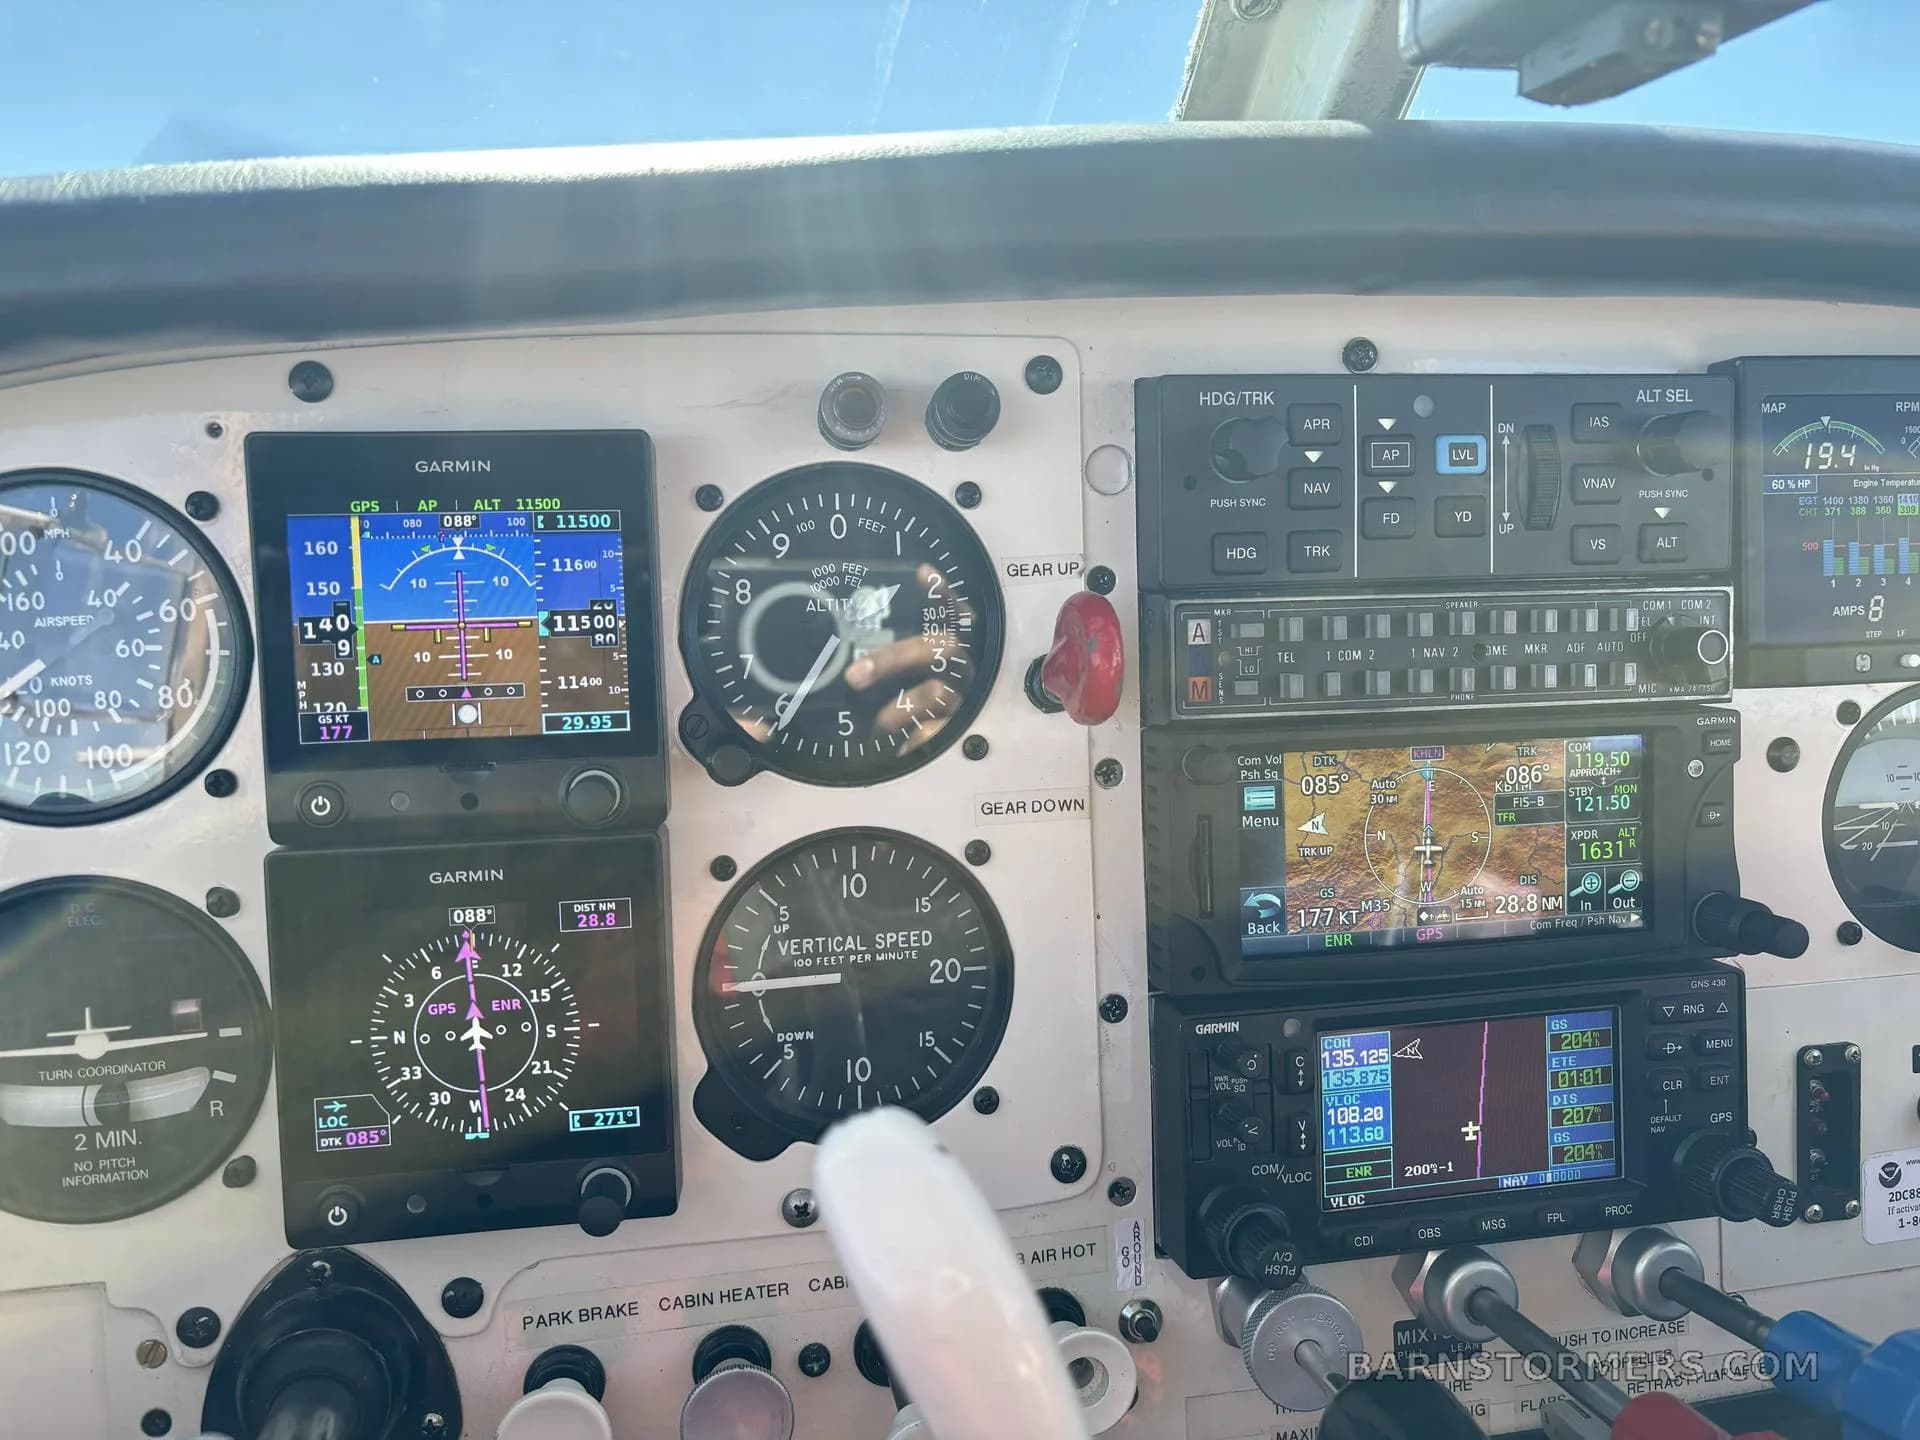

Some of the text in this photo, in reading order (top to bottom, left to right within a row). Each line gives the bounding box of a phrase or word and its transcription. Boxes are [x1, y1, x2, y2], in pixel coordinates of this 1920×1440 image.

[1199, 391, 1275, 406] HDG/TRK
[1636, 389, 1693, 403] ALT SEL
[1761, 403, 1786, 413] MAP
[1896, 402, 1919, 412] RPM
[1303, 418, 1331, 430] APR
[1498, 423, 1514, 433] DN
[1589, 416, 1609, 428] IAS
[1382, 449, 1400, 461] AP
[1452, 449, 1474, 460] LVL
[1804, 443, 1857, 470] 19.4
[415, 459, 491, 473] GARMIN
[1304, 482, 1331, 494] NAV
[1583, 478, 1616, 489] VNAV
[1772, 479, 1811, 489] 60 HP
[1853, 479, 1879, 488] Engine
[1639, 490, 1663, 498] PUSH
[351, 498, 561, 512] GPS AP ALT 11500
[1210, 498, 1266, 508] PUSH SYNC
[1454, 511, 1472, 522] YD
[1825, 507, 1841, 515] 371
[556, 514, 611, 529] 11500
[1383, 513, 1400, 524] FD
[857, 517, 887, 535] FEET
[1498, 524, 1514, 534] UP
[304, 540, 338, 556] 160
[1590, 539, 1606, 550] VS
[1656, 536, 1678, 548] ALT
[104, 540, 143, 564] 40
[1226, 547, 1257, 560] HDG
[1304, 546, 1331, 558] TRK
[1007, 562, 1080, 576] GEAR UP
[306, 580, 340, 596] 150
[8, 591, 46, 612] 160
[87, 589, 118, 608] 40
[160, 599, 197, 623] 60
[1832, 606, 1865, 616] AMPS
[1630, 633, 1647, 644] OFF
[115, 639, 145, 658] 60
[1423, 647, 1445, 659] NAV
[1524, 643, 1548, 655] MKR
[1597, 641, 1624, 653] AUTO
[1277, 651, 1296, 664] TEL
[1338, 650, 1362, 662] COM
[311, 661, 345, 677] 130
[51, 675, 93, 687] KNOTS
[1638, 683, 1657, 695] MIC
[94, 690, 122, 709] 80
[35, 699, 71, 717] 100
[561, 715, 612, 731] 29.95
[1697, 715, 1737, 726] GARMIN
[1568, 742, 1591, 753] COM
[1710, 738, 1732, 748] HOME
[1517, 746, 1537, 757] TRK
[1238, 755, 1262, 767] Com
[1313, 755, 1337, 767] DTK
[1575, 751, 1630, 769] 119.50
[1371, 779, 1397, 791] Auto
[1886, 774, 1894, 782] 10
[1568, 784, 1638, 798] STBY MON
[981, 799, 1085, 815] GEAR DOWN
[1575, 794, 1630, 813] 121.50
[1242, 815, 1279, 828] Menu
[1497, 813, 1516, 823] TFR
[1881, 821, 1889, 830] 10
[1570, 827, 1637, 841] XPDR ALT
[1578, 840, 1624, 861] 1631
[1862, 842, 1873, 851] 20
[429, 868, 504, 884] GARMIN
[1519, 874, 1538, 886] DIS
[842, 873, 867, 899] 10
[1320, 888, 1335, 899] GS
[573, 902, 616, 913] DIST NM
[915, 896, 932, 913] 15
[1495, 894, 1563, 915] 28.8 NM
[1581, 897, 1636, 912] In Out
[577, 912, 616, 928] 28.8
[1297, 907, 1360, 929] 177 KT
[1247, 920, 1281, 935] Back
[1416, 927, 1443, 941] GPS
[778, 929, 933, 956] VERTICAL SPEED
[1325, 933, 1353, 947] ENR
[816, 950, 918, 966] FEET PER MINUTE
[502, 963, 523, 978] 12
[929, 957, 962, 984] 20
[530, 989, 551, 1004] 15
[428, 998, 522, 1016] GPS ENR
[1683, 1003, 1705, 1014] RNG
[1195, 1021, 1240, 1035] GARMIN
[1552, 1019, 1568, 1030] GS
[777, 1030, 814, 1042] DOWN
[1706, 1039, 1733, 1049] MENU
[1323, 1048, 1389, 1069] 135.125
[1552, 1055, 1577, 1067] ETE
[39, 1060, 167, 1081] TURN COORDINATOR
[401, 1066, 422, 1081] 33
[531, 1060, 552, 1076] 21
[847, 1056, 872, 1082] 10
[1323, 1069, 1389, 1089] 135.875
[1558, 1068, 1602, 1089] 01:01
[1662, 1080, 1682, 1091] CLR
[1710, 1075, 1729, 1085] ENT
[429, 1091, 451, 1107] 30
[504, 1087, 526, 1103] 24
[318, 1115, 349, 1129] LOC
[1328, 1105, 1384, 1126] 108.20
[1650, 1114, 1682, 1124] DEFAULT
[1710, 1112, 1733, 1123] GPS
[320, 1136, 342, 1147] DTK
[1328, 1126, 1384, 1146] 113.60
[1554, 1132, 1570, 1143] GS
[74, 1156, 136, 1173] NO PITCH
[61, 1168, 149, 1188] INFORMATION
[1346, 1165, 1373, 1179] ENR
[1330, 1194, 1366, 1208] VLOC
[1783, 1190, 1798, 1222] PUSH
[1605, 1204, 1633, 1216] PROC
[1482, 1219, 1506, 1231] MSG
[1547, 1213, 1566, 1223] FPL
[1417, 1228, 1441, 1239] OBS
[1354, 1236, 1373, 1247] CDI
[1031, 1248, 1057, 1265] AIR
[1062, 1242, 1097, 1260] HOT
[1132, 1220, 1143, 1287] AROUND
[1264, 1264, 1297, 1276] PUSH
[658, 1281, 789, 1311] CABIN HEATER
[522, 1301, 639, 1330] PARK BRAKE
[1592, 1320, 1685, 1344] TO INCREASE
[1451, 1342, 1479, 1353] LEAN
